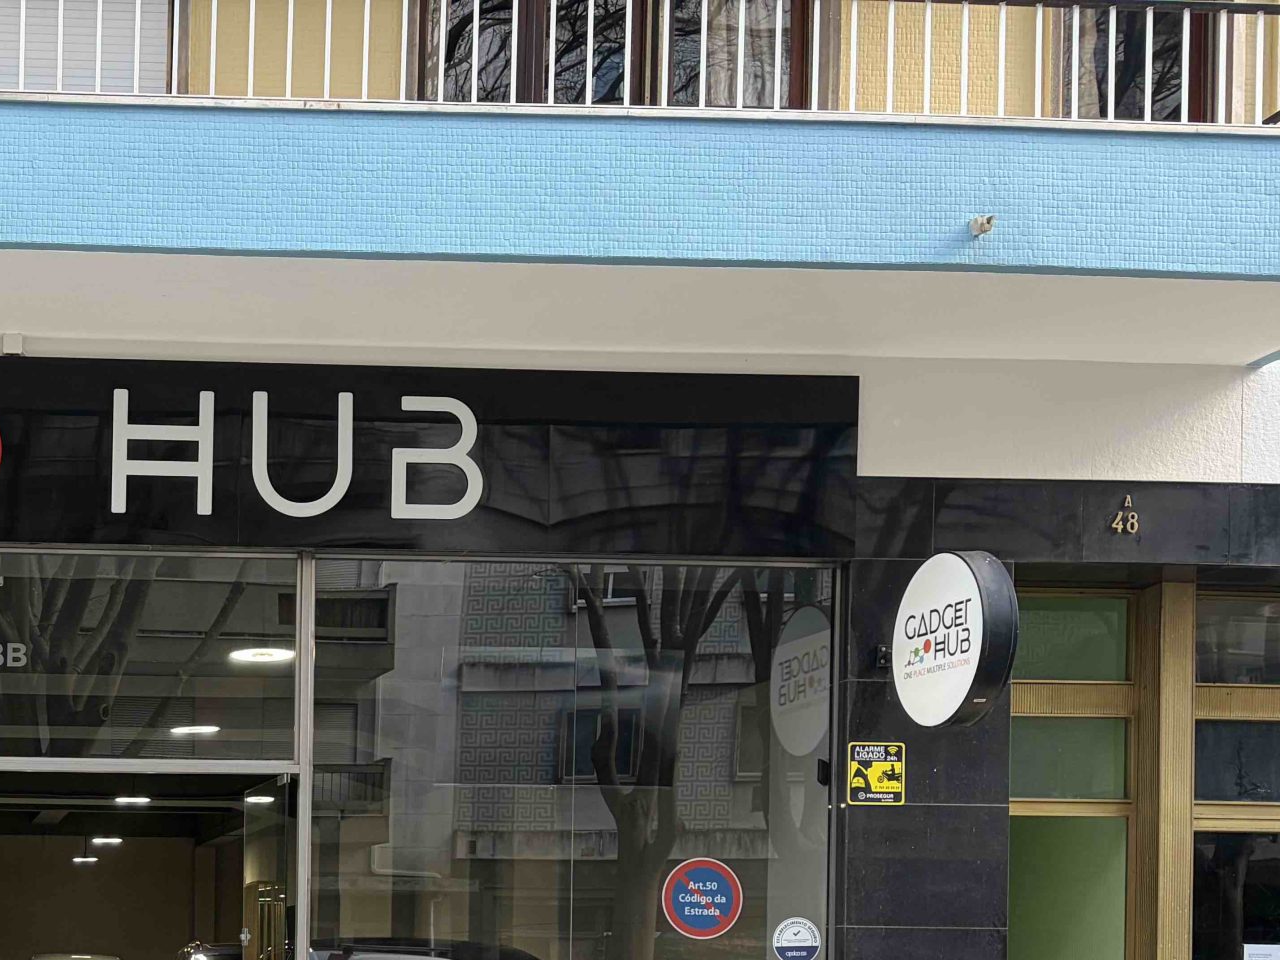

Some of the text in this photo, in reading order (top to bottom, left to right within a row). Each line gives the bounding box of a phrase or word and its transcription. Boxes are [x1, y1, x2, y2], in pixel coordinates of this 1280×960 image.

[109, 387, 484, 521] HUB
[1124, 494, 1132, 507] A
[1111, 511, 1139, 534] 48
[904, 597, 972, 640] GADGET
[934, 627, 971, 661] HUB
[913, 668, 927, 678] PLACE
[688, 881, 718, 890] Art.50
[678, 893, 726, 905] Código da
[684, 906, 720, 916] Estrada
